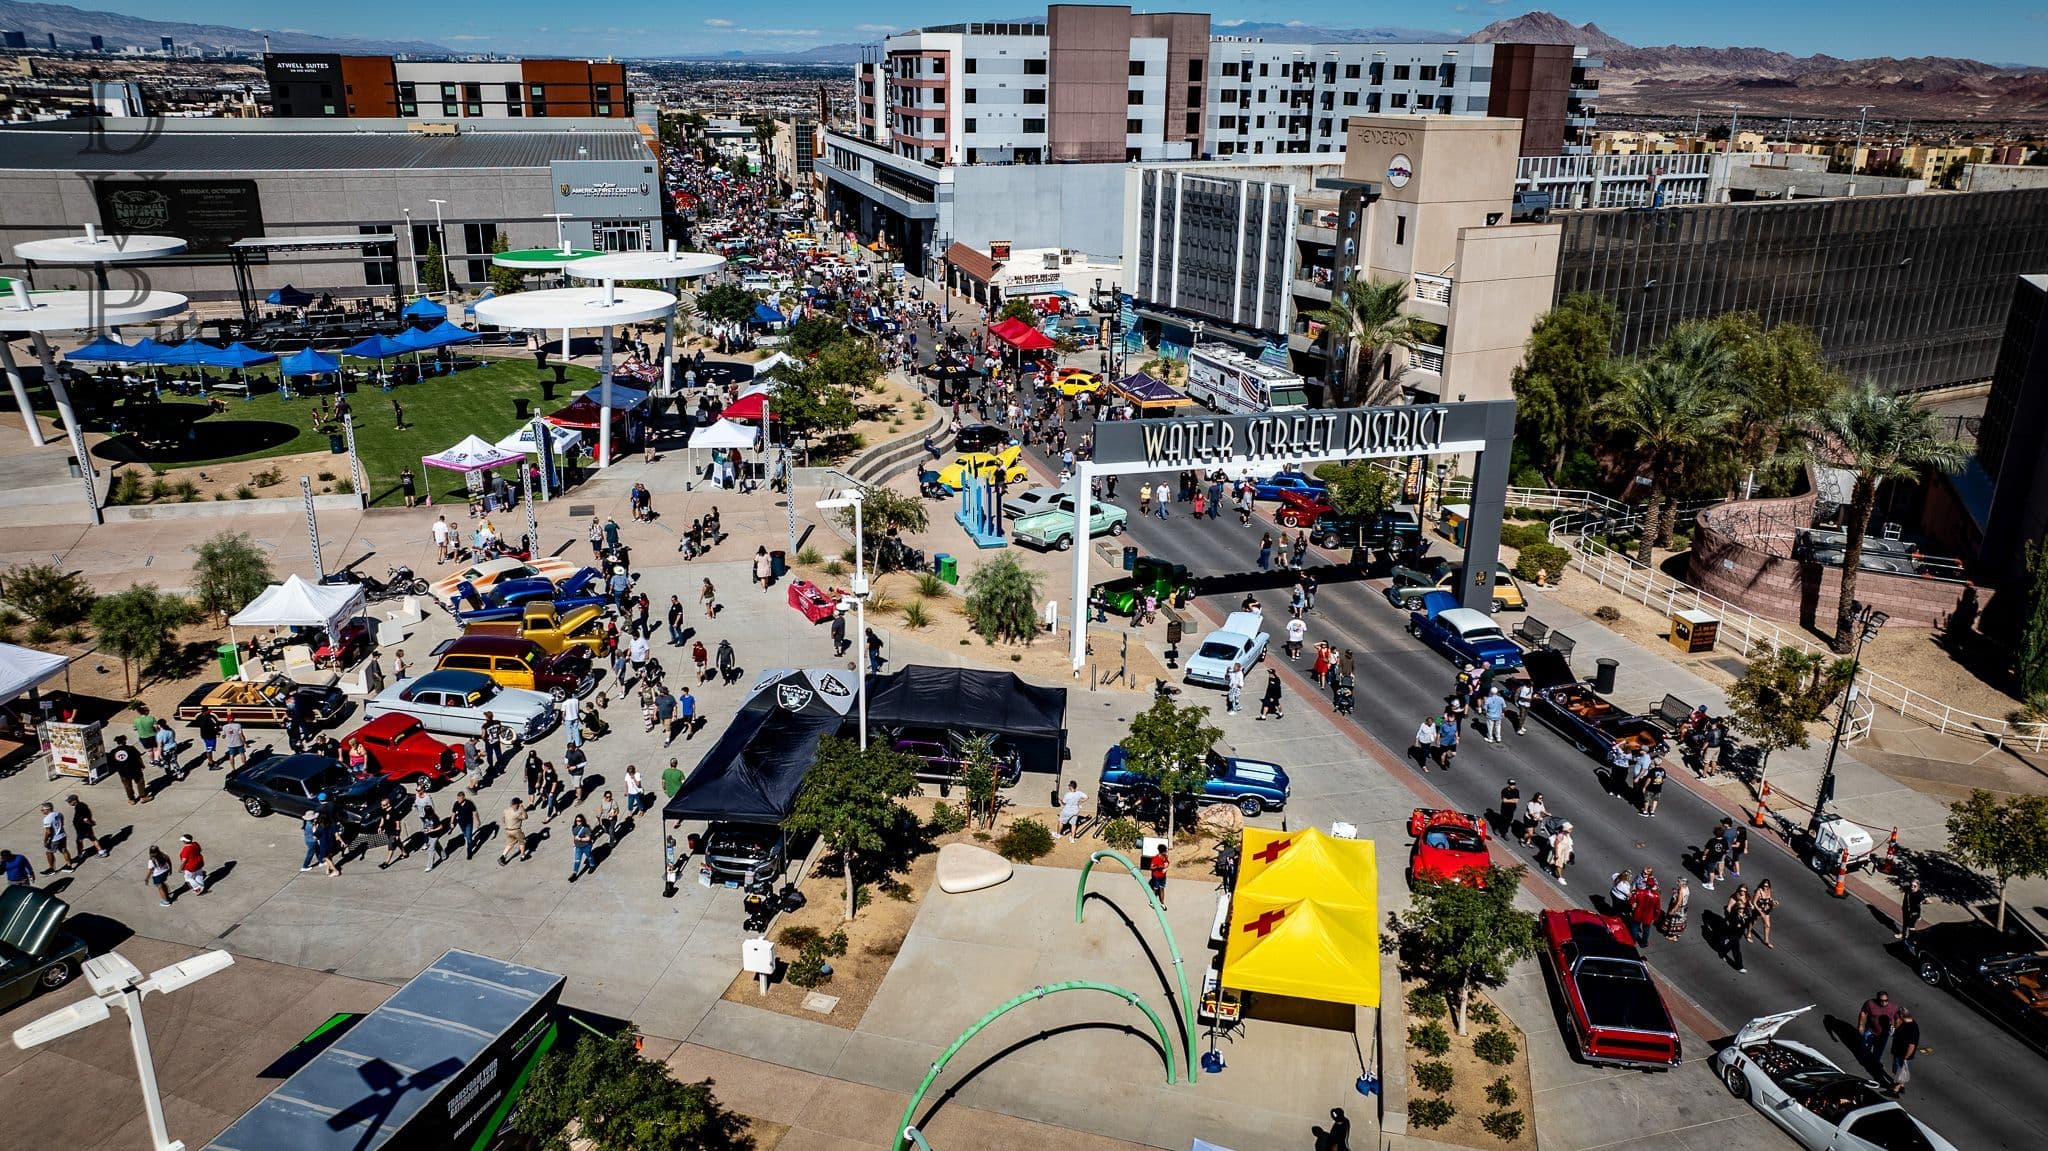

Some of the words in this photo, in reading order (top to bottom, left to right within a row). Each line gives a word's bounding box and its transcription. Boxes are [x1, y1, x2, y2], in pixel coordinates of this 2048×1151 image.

[1357, 129, 1415, 146] HENDERSON
[115, 208, 165, 219] NIGHT
[1145, 420, 1234, 466] WATER
[1248, 415, 1338, 456] STREET
[1348, 409, 1449, 450] DISTRICT
[448, 1071, 482, 1112] TRANSFORM
[483, 1057, 498, 1079] YOUR
[479, 1070, 497, 1090] TODAY
